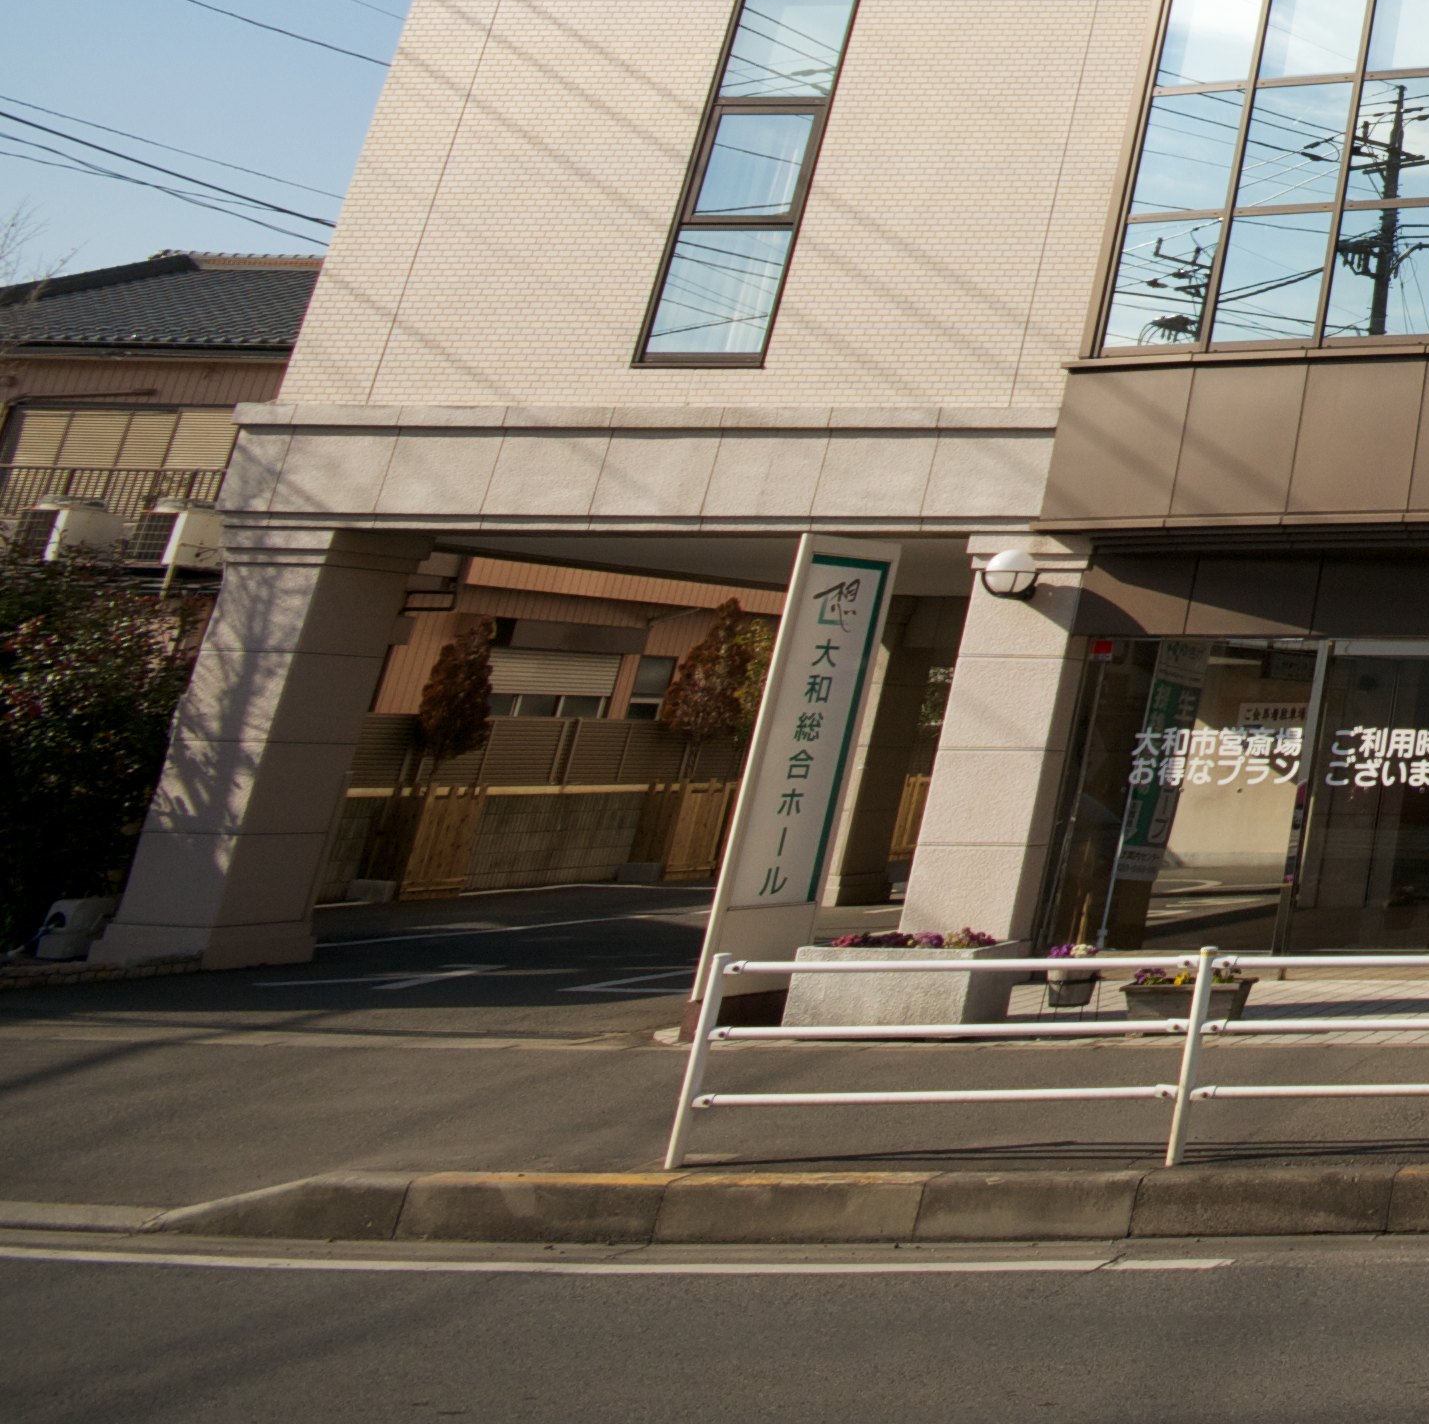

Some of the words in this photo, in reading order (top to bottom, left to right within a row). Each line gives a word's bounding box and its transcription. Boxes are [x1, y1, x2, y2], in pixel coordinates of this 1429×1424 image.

[1130, 726, 1303, 757] 大和市営斎場
[759, 638, 840, 897] 大和総合ホール
[1128, 757, 1300, 786] お得なプラン
